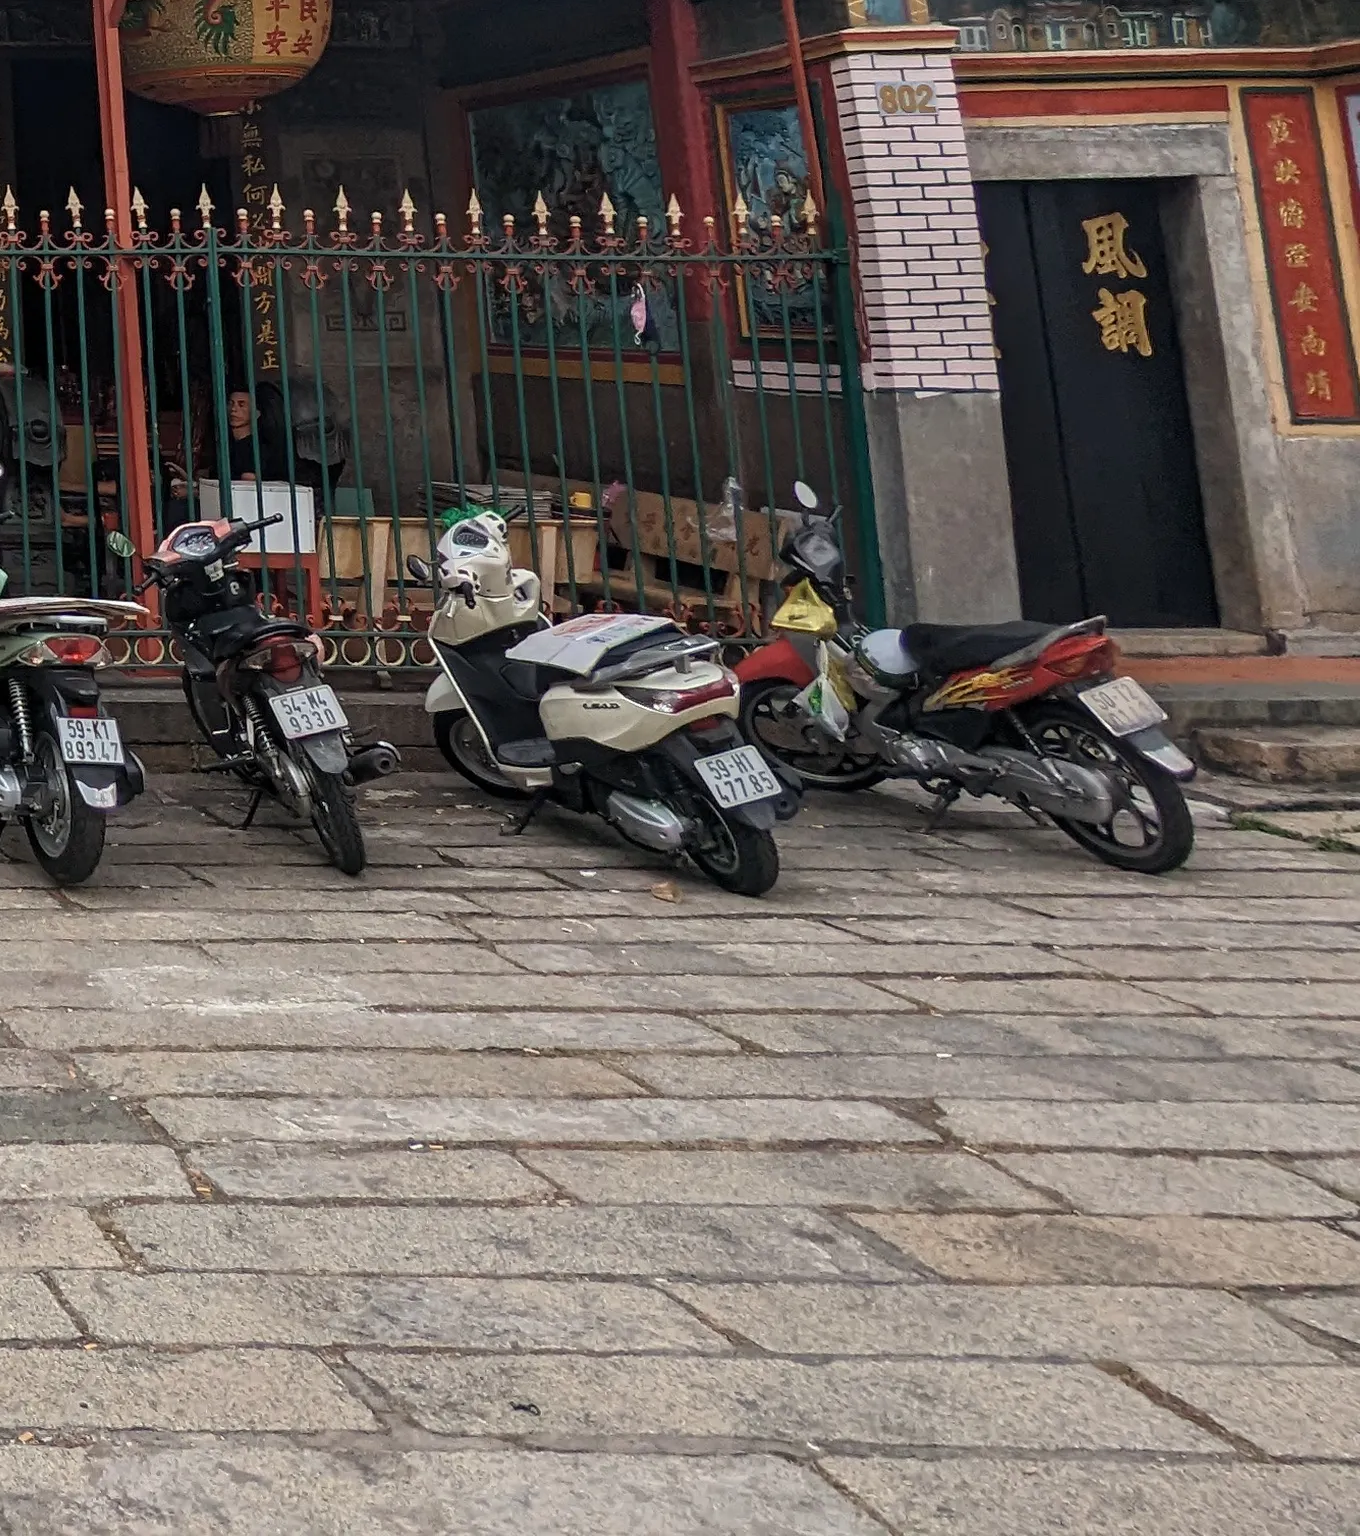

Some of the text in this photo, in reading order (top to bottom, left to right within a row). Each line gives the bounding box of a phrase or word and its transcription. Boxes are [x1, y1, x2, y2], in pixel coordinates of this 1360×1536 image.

[879, 84, 937, 114] 802
[280, 690, 328, 715] 54-M4
[67, 720, 109, 739] 59-K1
[289, 708, 337, 733] 9330
[64, 741, 118, 761] 893.47
[705, 752, 755, 780] 59-H1
[715, 771, 774, 803] 477.85
